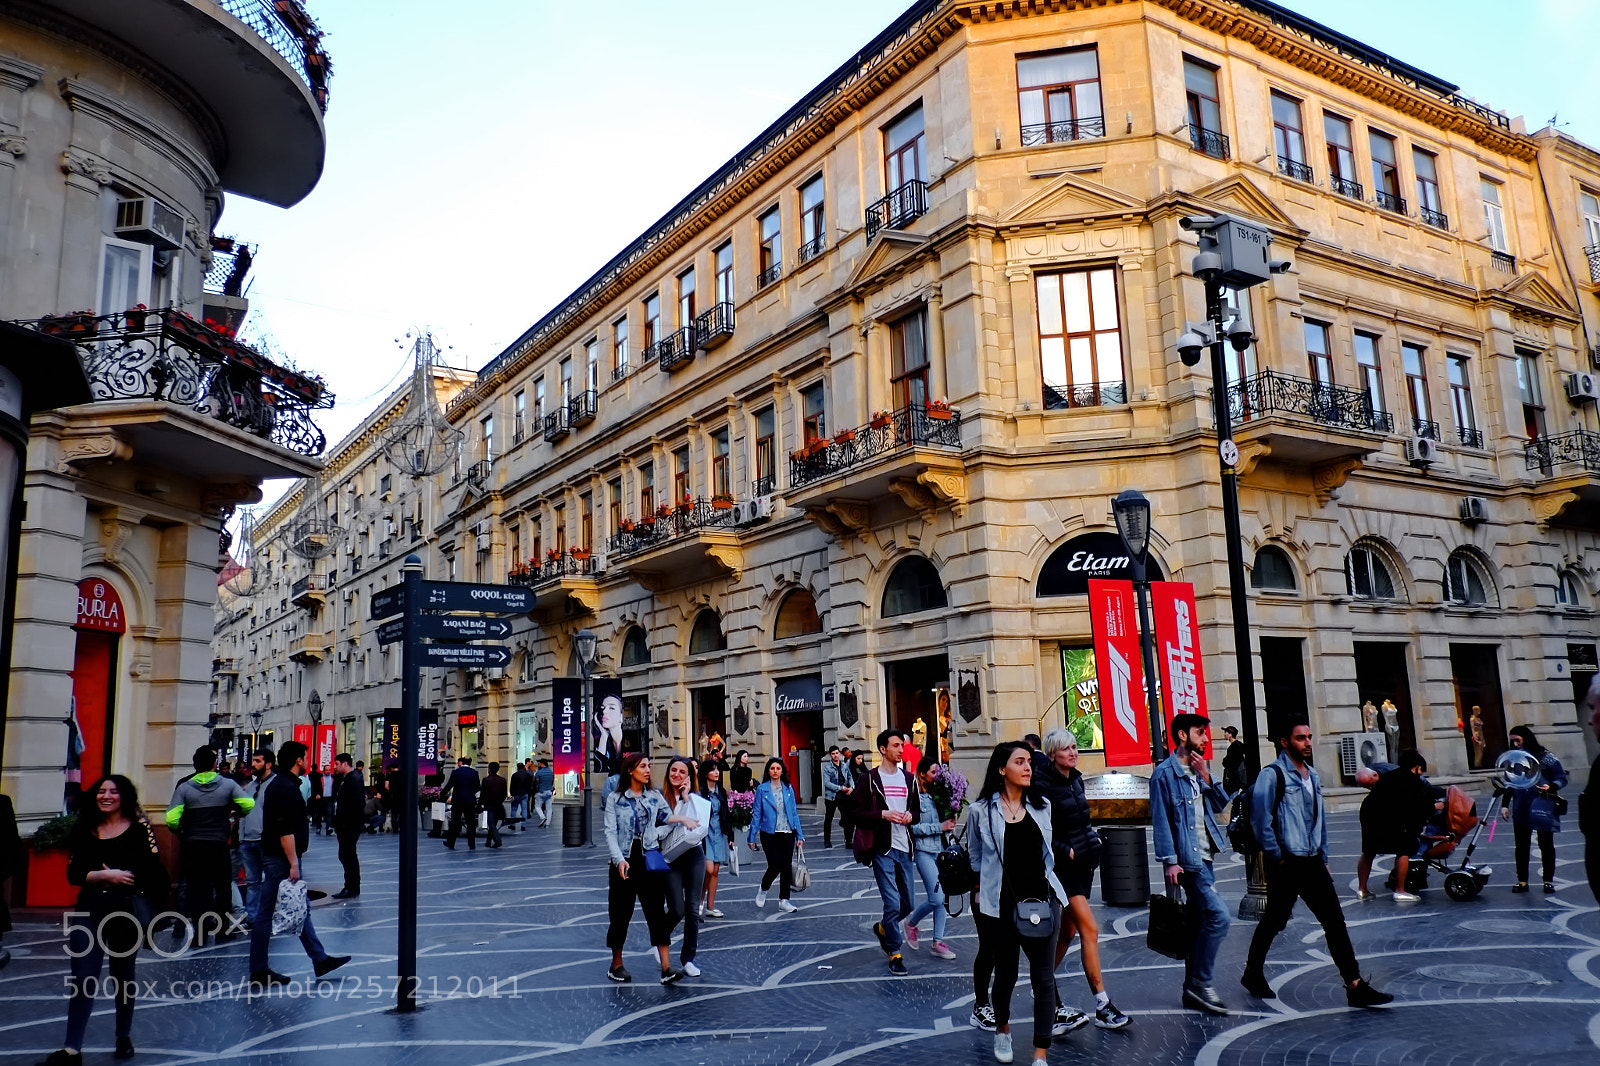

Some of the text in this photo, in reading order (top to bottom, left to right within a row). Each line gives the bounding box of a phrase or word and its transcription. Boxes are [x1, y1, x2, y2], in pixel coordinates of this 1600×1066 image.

[1236, 226, 1260, 244] TS1-161
[1067, 551, 1130, 571] Etam
[470, 589, 502, 599] QOQOL
[77, 596, 118, 620] BURLA
[442, 620, 469, 628] XAQANİ
[1076, 678, 1098, 697] WH
[1166, 641, 1186, 716] TREET
[776, 694, 805, 711] Etam
[562, 697, 574, 753] Dua Lipa
[389, 724, 400, 758] 29 Aprel
[418, 726, 427, 757] Martin
[426, 723, 437, 760] Solveig
